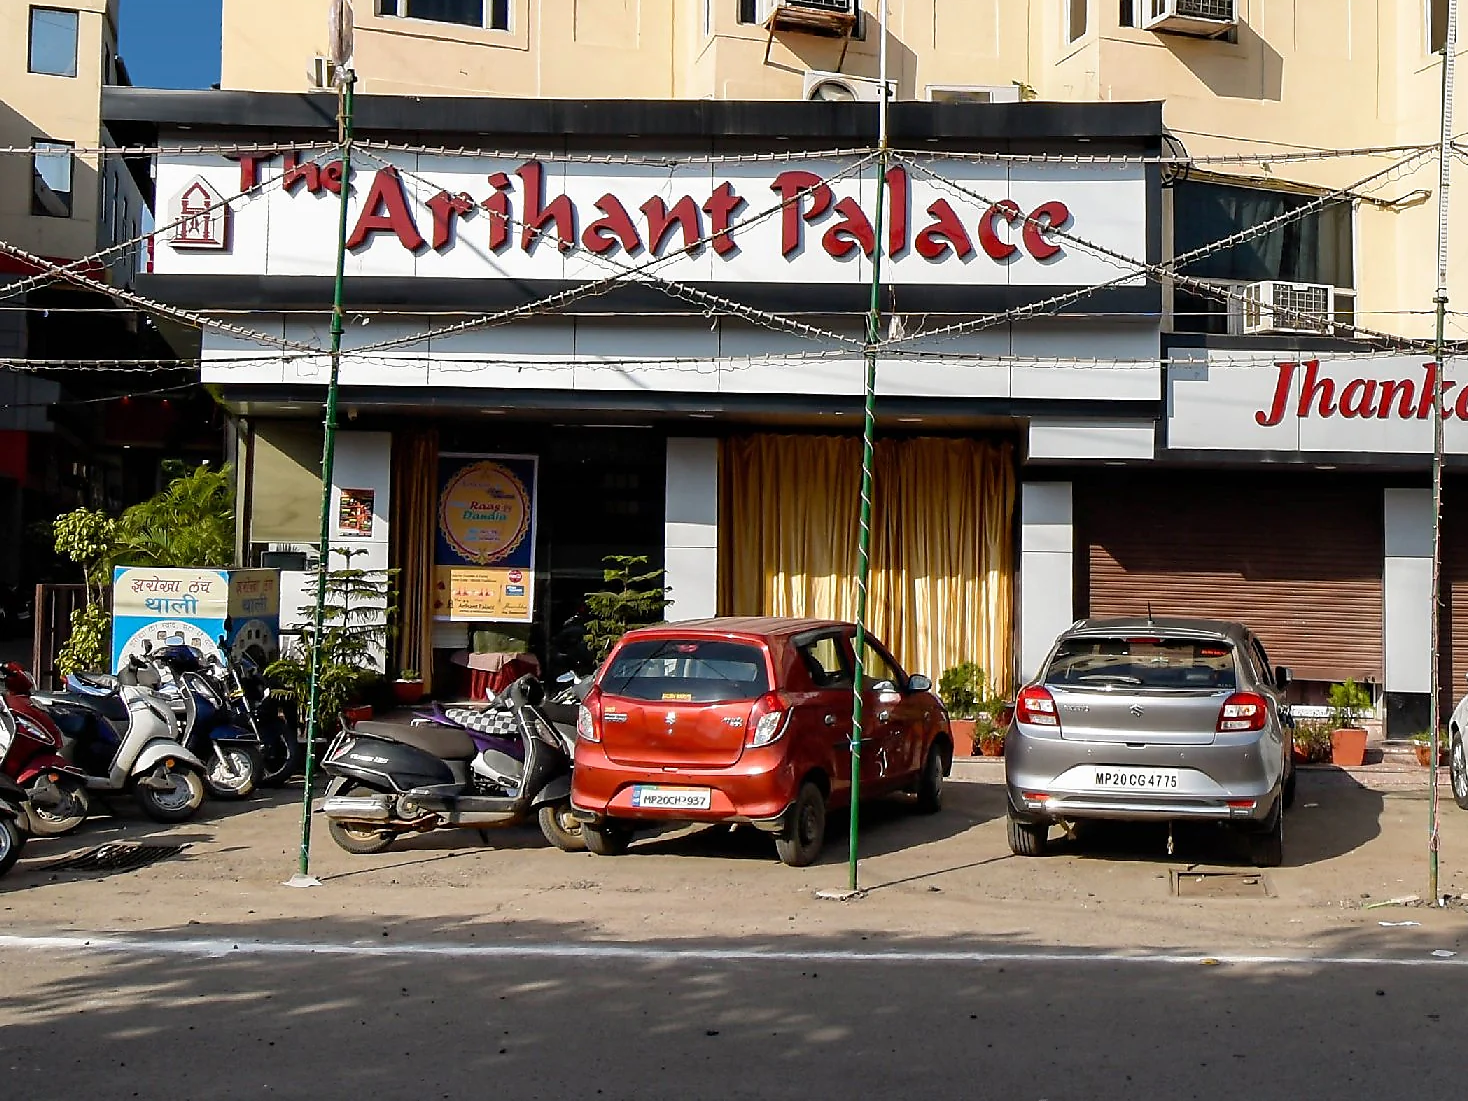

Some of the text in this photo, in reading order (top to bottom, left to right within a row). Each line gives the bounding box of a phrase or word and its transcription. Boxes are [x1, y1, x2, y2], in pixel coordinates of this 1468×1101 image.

[224, 150, 1070, 259] The Arihant Palace
[131, 576, 212, 593] झरोखा लंच
[145, 593, 199, 614] थाली
